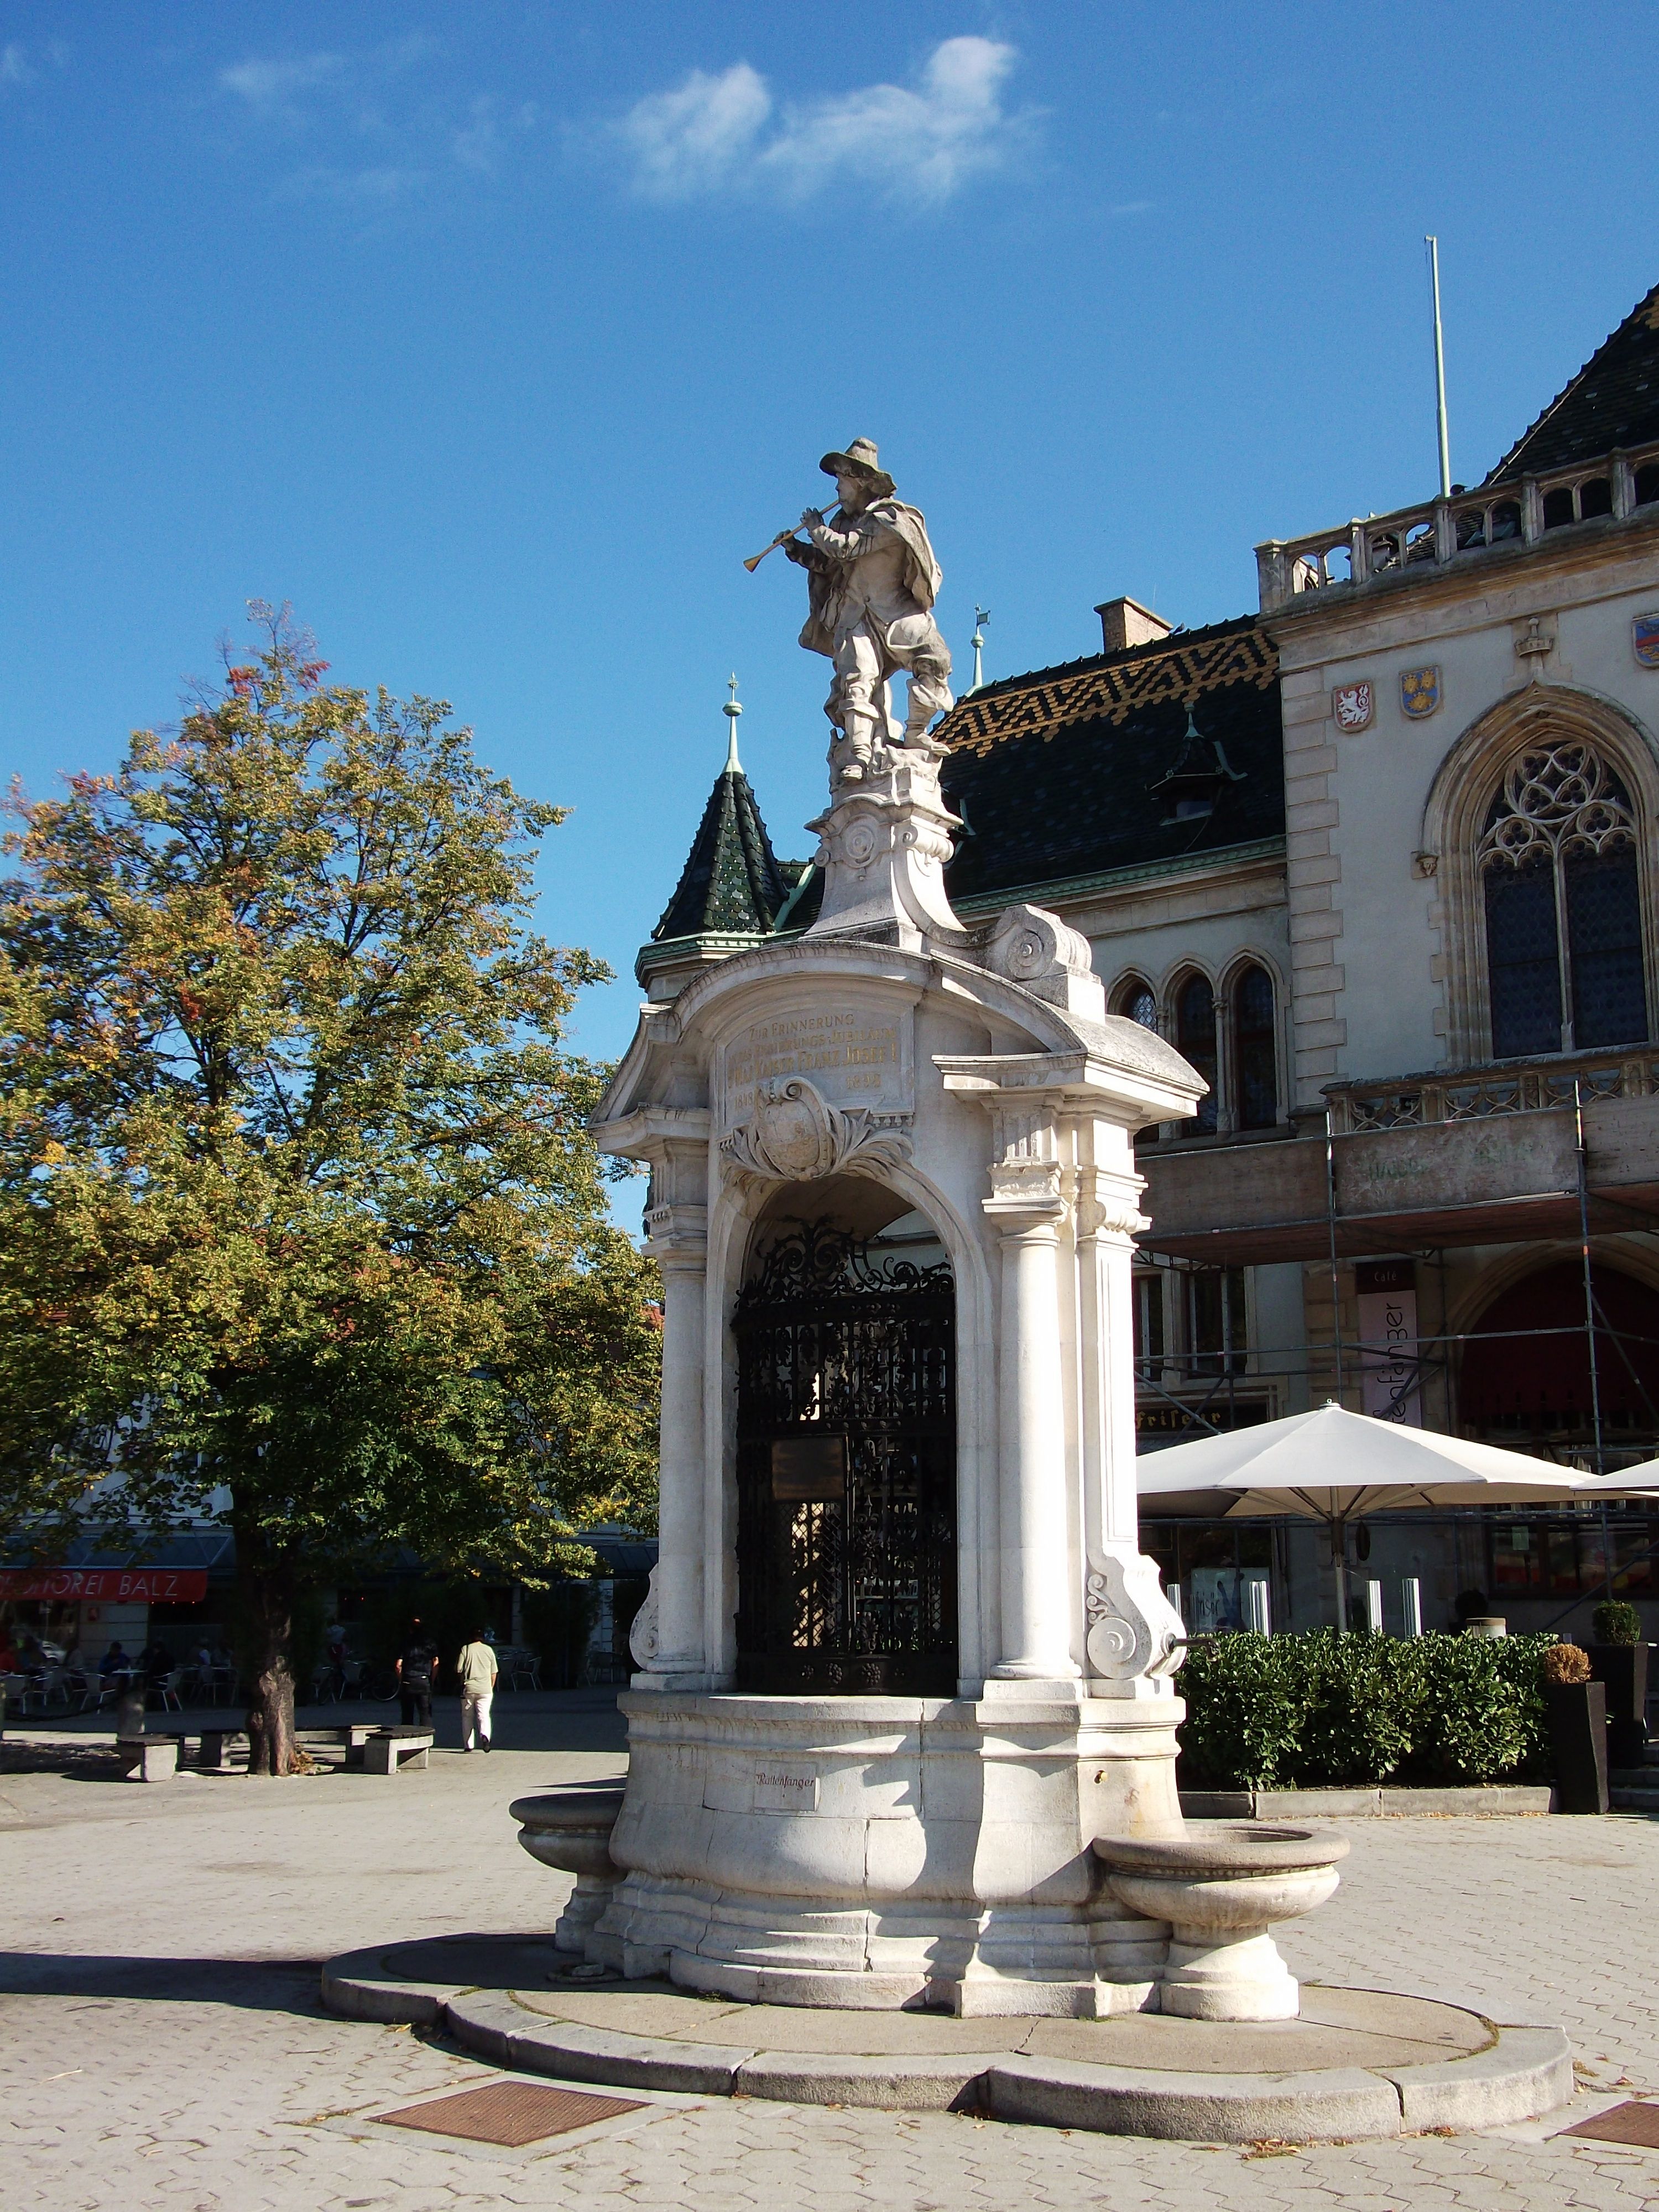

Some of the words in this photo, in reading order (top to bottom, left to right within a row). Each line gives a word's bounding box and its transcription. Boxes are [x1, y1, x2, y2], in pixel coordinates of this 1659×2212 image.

[771, 1013, 854, 1036] ERINNERUNG
[797, 1050, 840, 1071] FRANZ
[842, 1044, 886, 1066] JOSEF
[118, 1575, 178, 1596] BALZ
